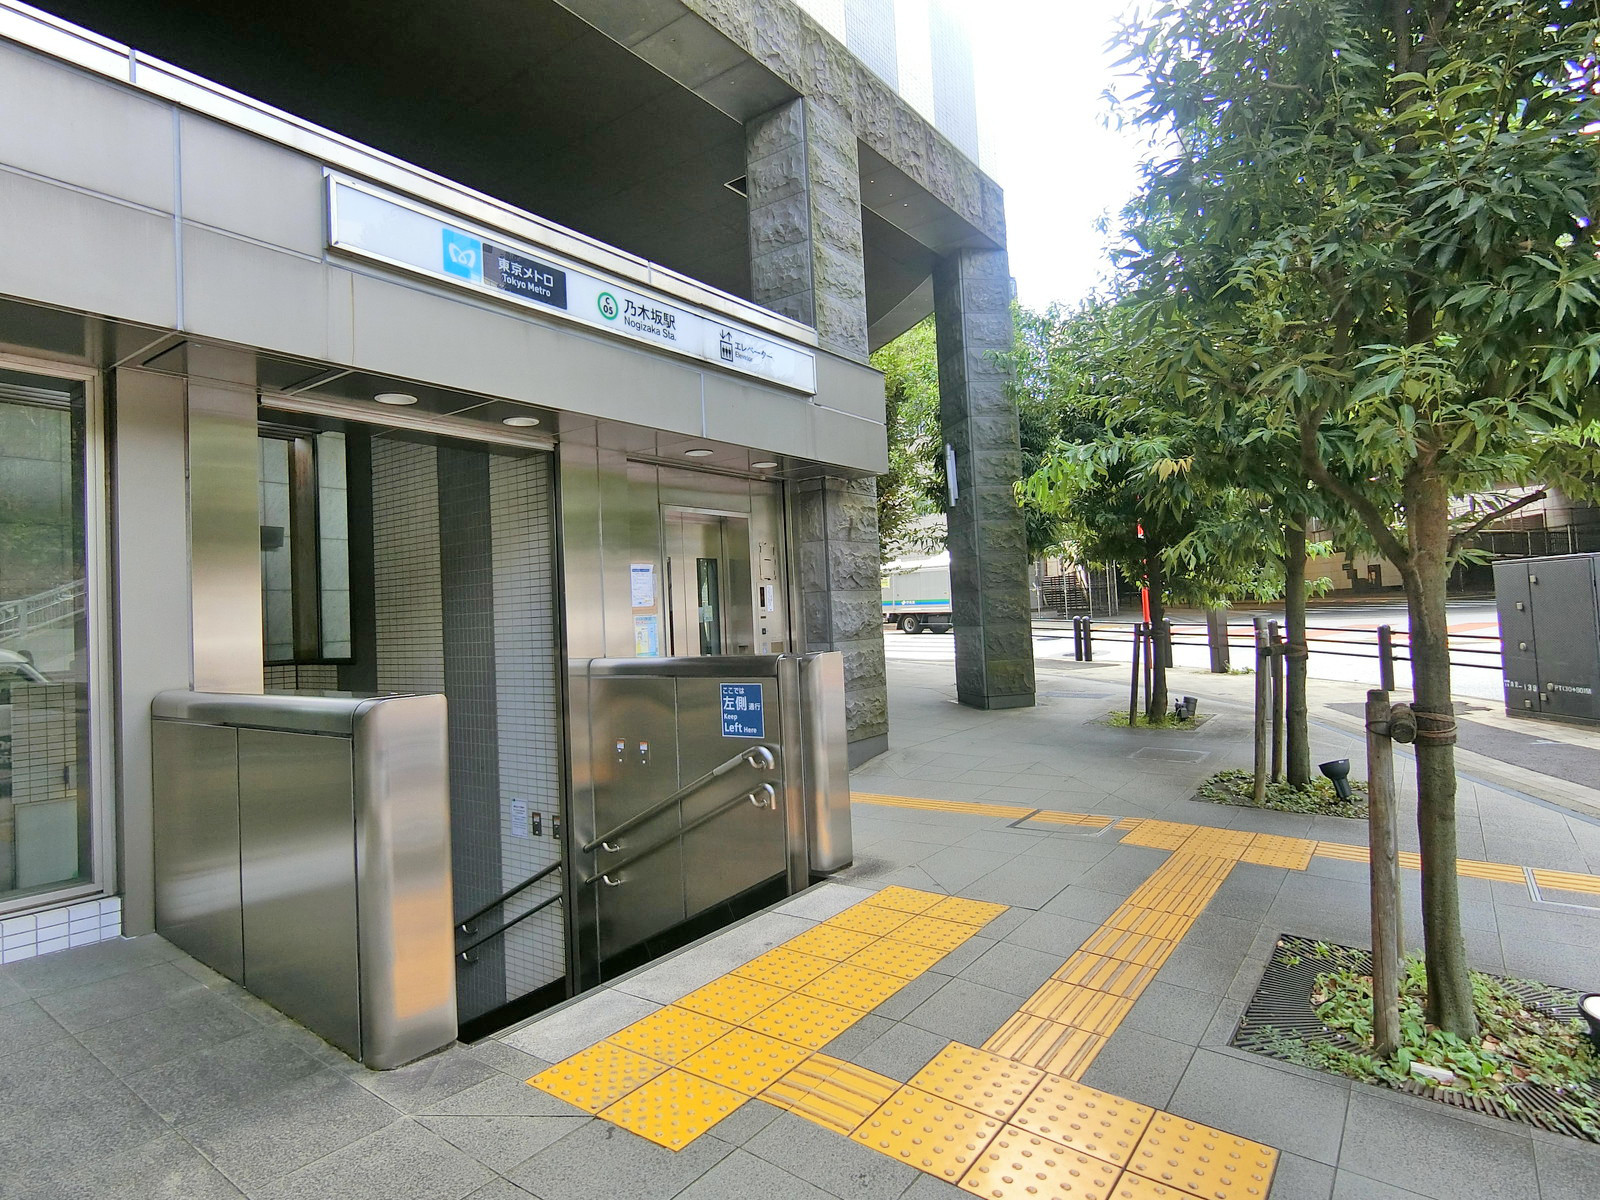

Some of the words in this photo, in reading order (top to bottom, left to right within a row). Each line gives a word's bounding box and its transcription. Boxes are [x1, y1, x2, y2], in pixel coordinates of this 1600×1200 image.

[497, 257, 554, 287] 東京メトロ
[501, 272, 527, 289] Tokyo
[527, 281, 551, 297] Metro
[603, 304, 614, 315] 05
[605, 297, 610, 305] C
[624, 299, 677, 330] 乃木坂駅
[624, 315, 661, 336] Nogizaka
[662, 328, 677, 341] Sta.
[735, 341, 773, 360] エレベーター
[723, 696, 760, 710] 左側通行
[724, 722, 742, 732] Left
